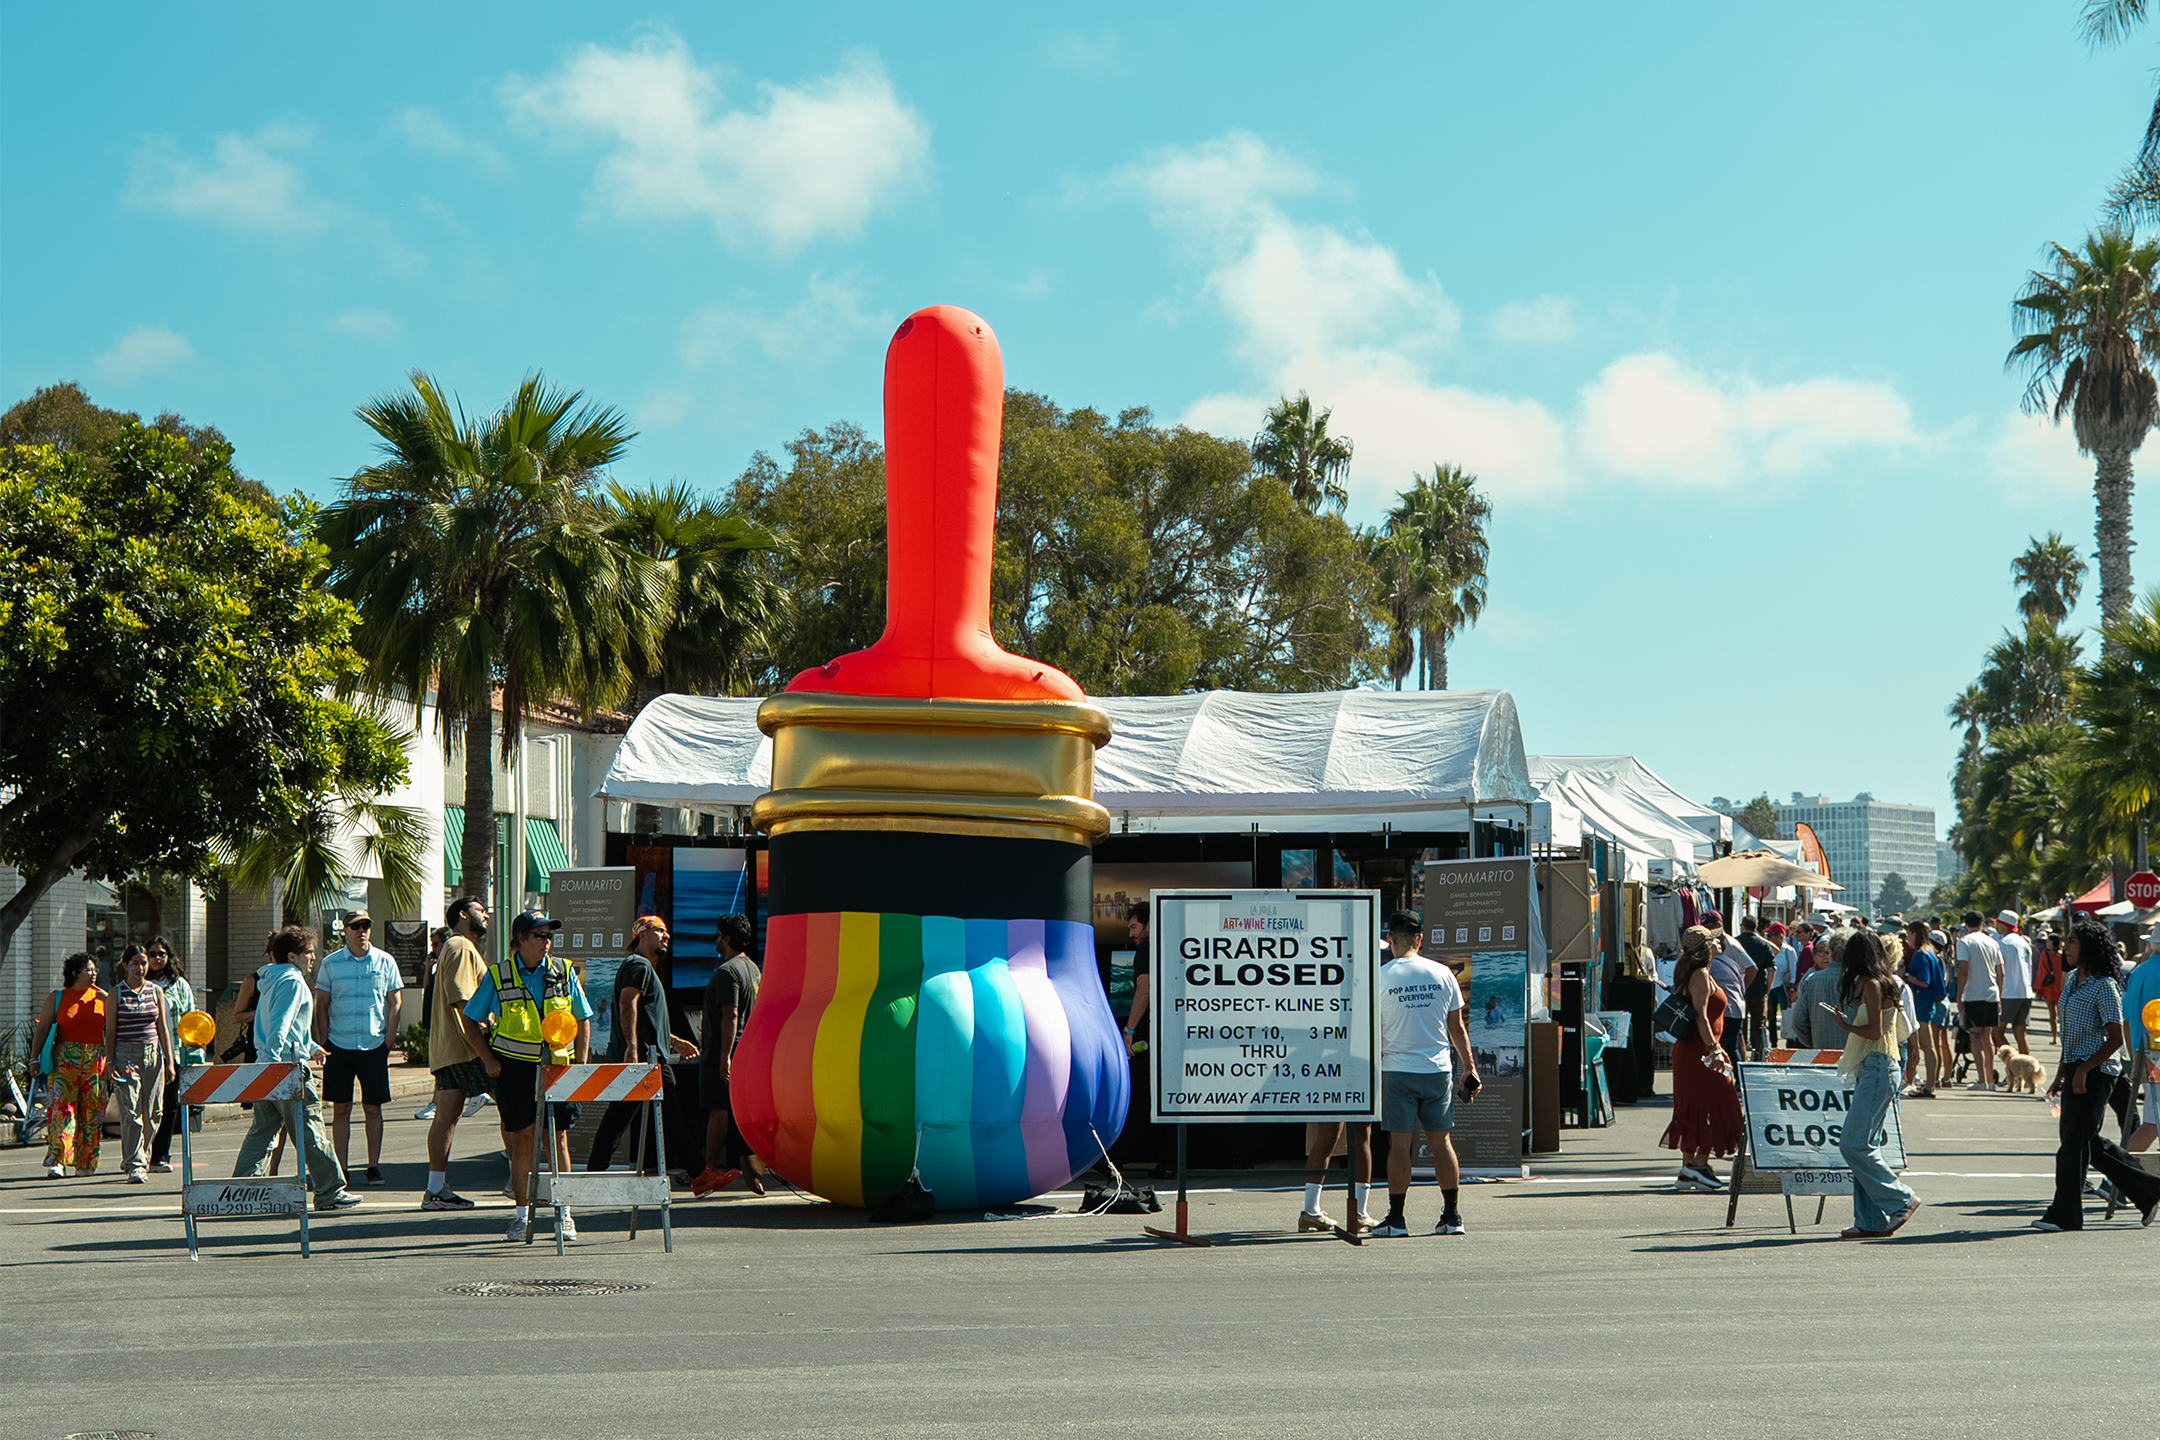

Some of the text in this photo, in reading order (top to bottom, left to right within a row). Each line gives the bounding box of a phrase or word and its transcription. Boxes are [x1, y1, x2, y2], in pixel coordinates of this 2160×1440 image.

[1439, 869, 1515, 885] BOMMARITO
[560, 879, 623, 892] BOMMARITO
[2127, 883, 2160, 898] STOP
[1250, 906, 1278, 916] LA JOLLA
[1268, 918, 1304, 929] FESTIVAL
[1179, 936, 1353, 959] GIRARD ST.
[1186, 964, 1345, 986] CLOSED
[1388, 986, 1403, 996] POP
[1404, 985, 1418, 993] ART
[1175, 998, 1353, 1012] PROSPECT- KLINE ST.
[1187, 1026, 1348, 1042] FRI OCT 10, 3 PM
[1240, 1044, 1287, 1058] THRU
[1185, 1063, 1342, 1080] MON OCT 13, 6 AM
[1167, 1092, 1365, 1105] TOW AWAY AFTER 12 PM FRI
[218, 1185, 273, 1202] ACME
